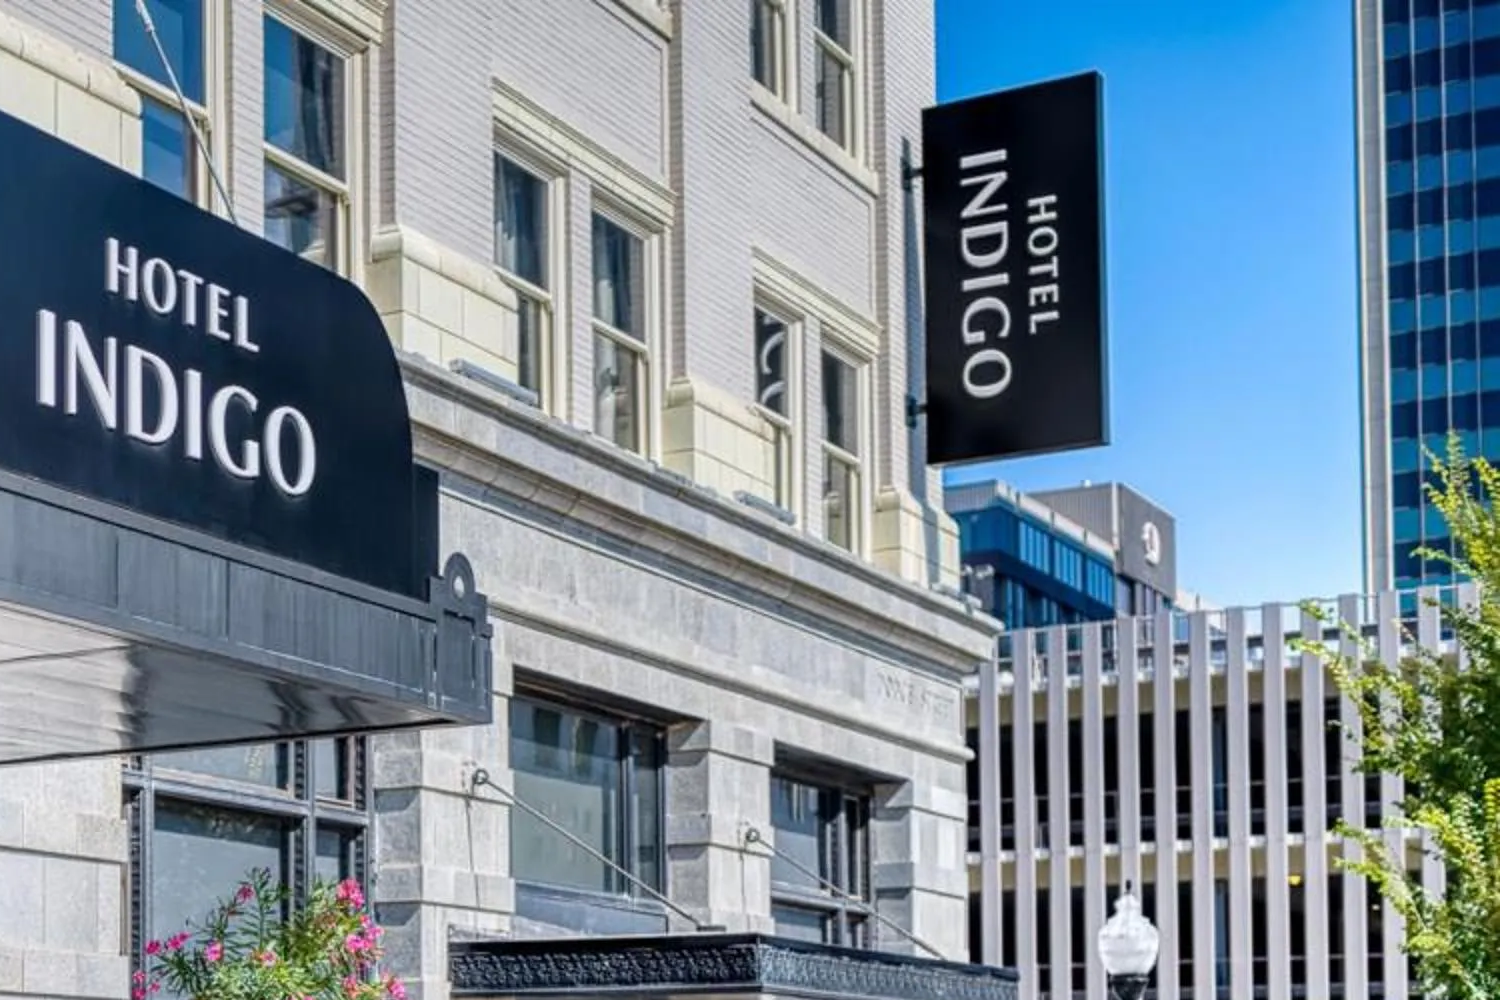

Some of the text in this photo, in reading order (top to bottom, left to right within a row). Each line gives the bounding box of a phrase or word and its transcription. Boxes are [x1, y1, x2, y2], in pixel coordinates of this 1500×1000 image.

[105, 236, 260, 353] HOTEL
[959, 148, 1013, 399] INDIGO
[1027, 194, 1060, 335] HOTEL
[35, 308, 317, 497] INDIGO
